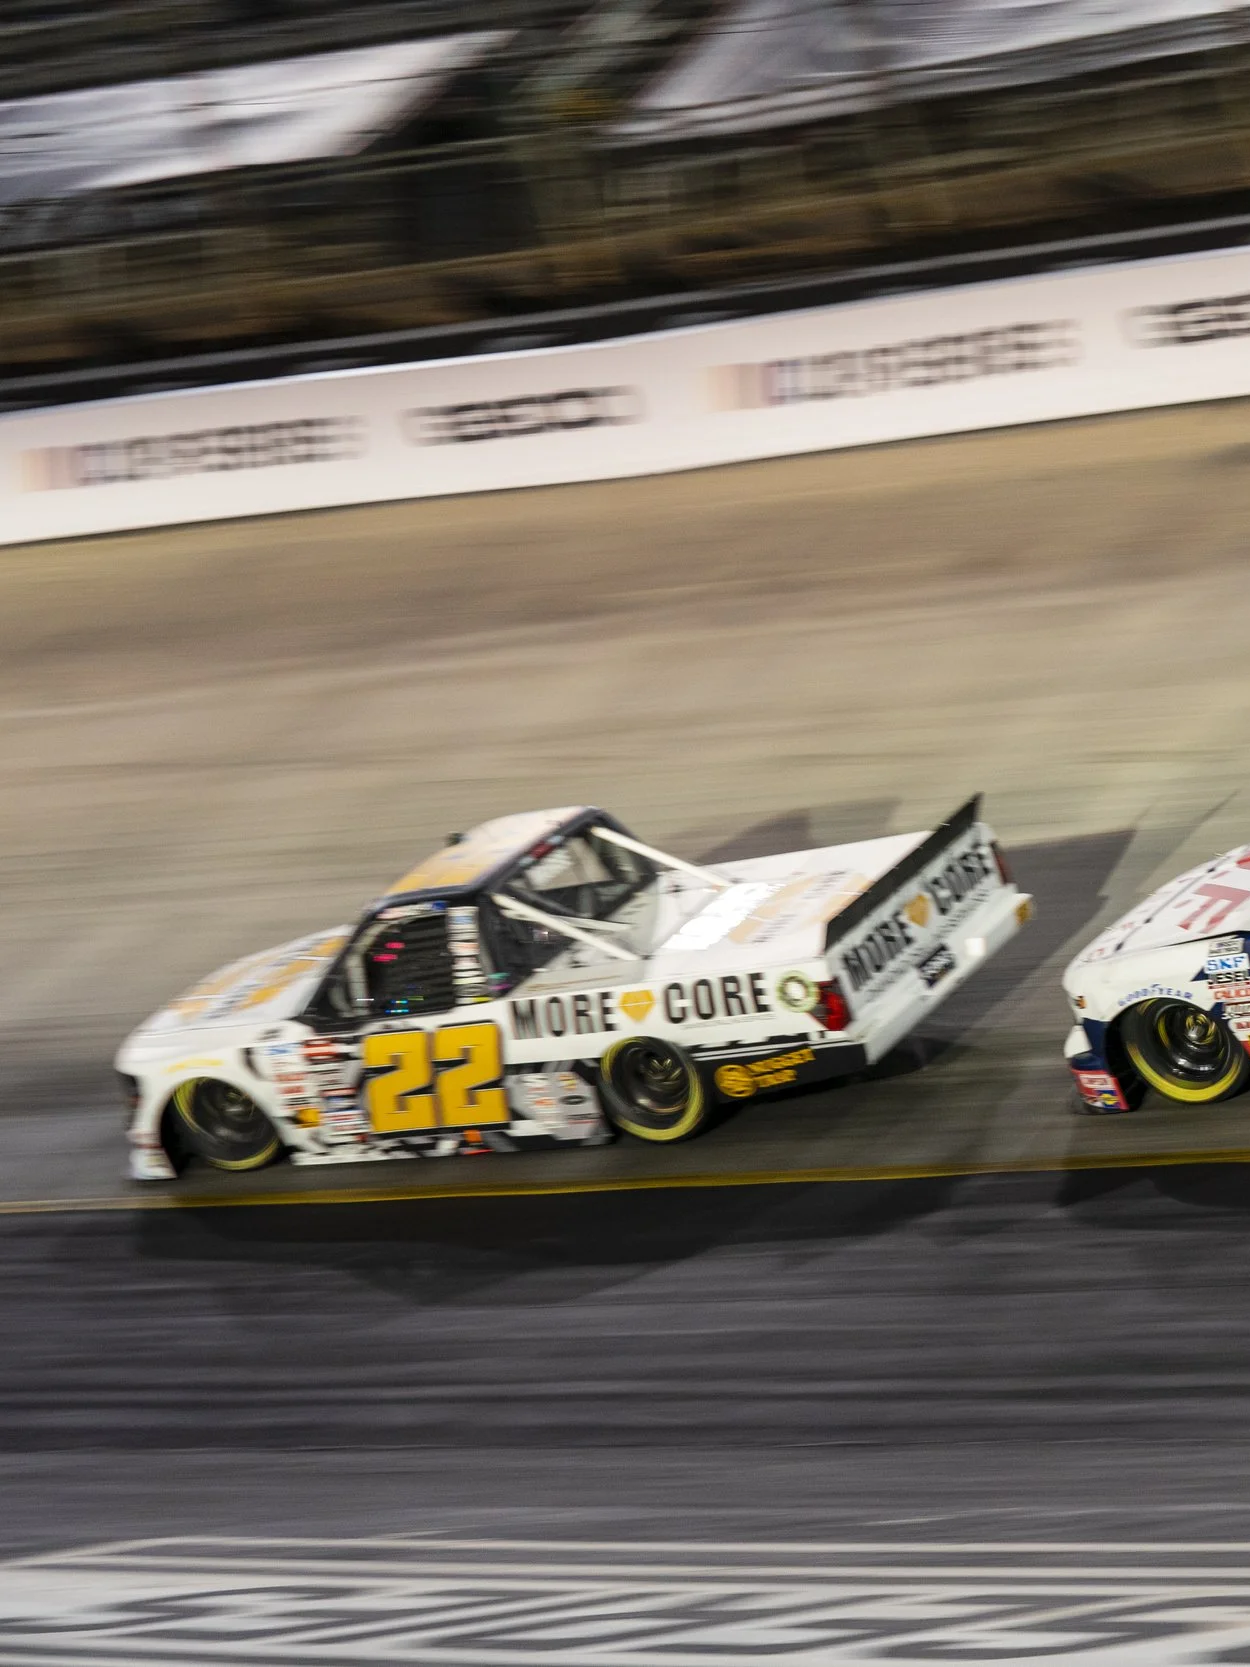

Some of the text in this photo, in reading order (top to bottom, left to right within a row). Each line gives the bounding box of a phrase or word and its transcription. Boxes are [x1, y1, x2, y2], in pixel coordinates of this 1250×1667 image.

[1207, 955, 1246, 972] SKF
[509, 971, 771, 1041] MORE CORE
[362, 1022, 509, 1134] 22
